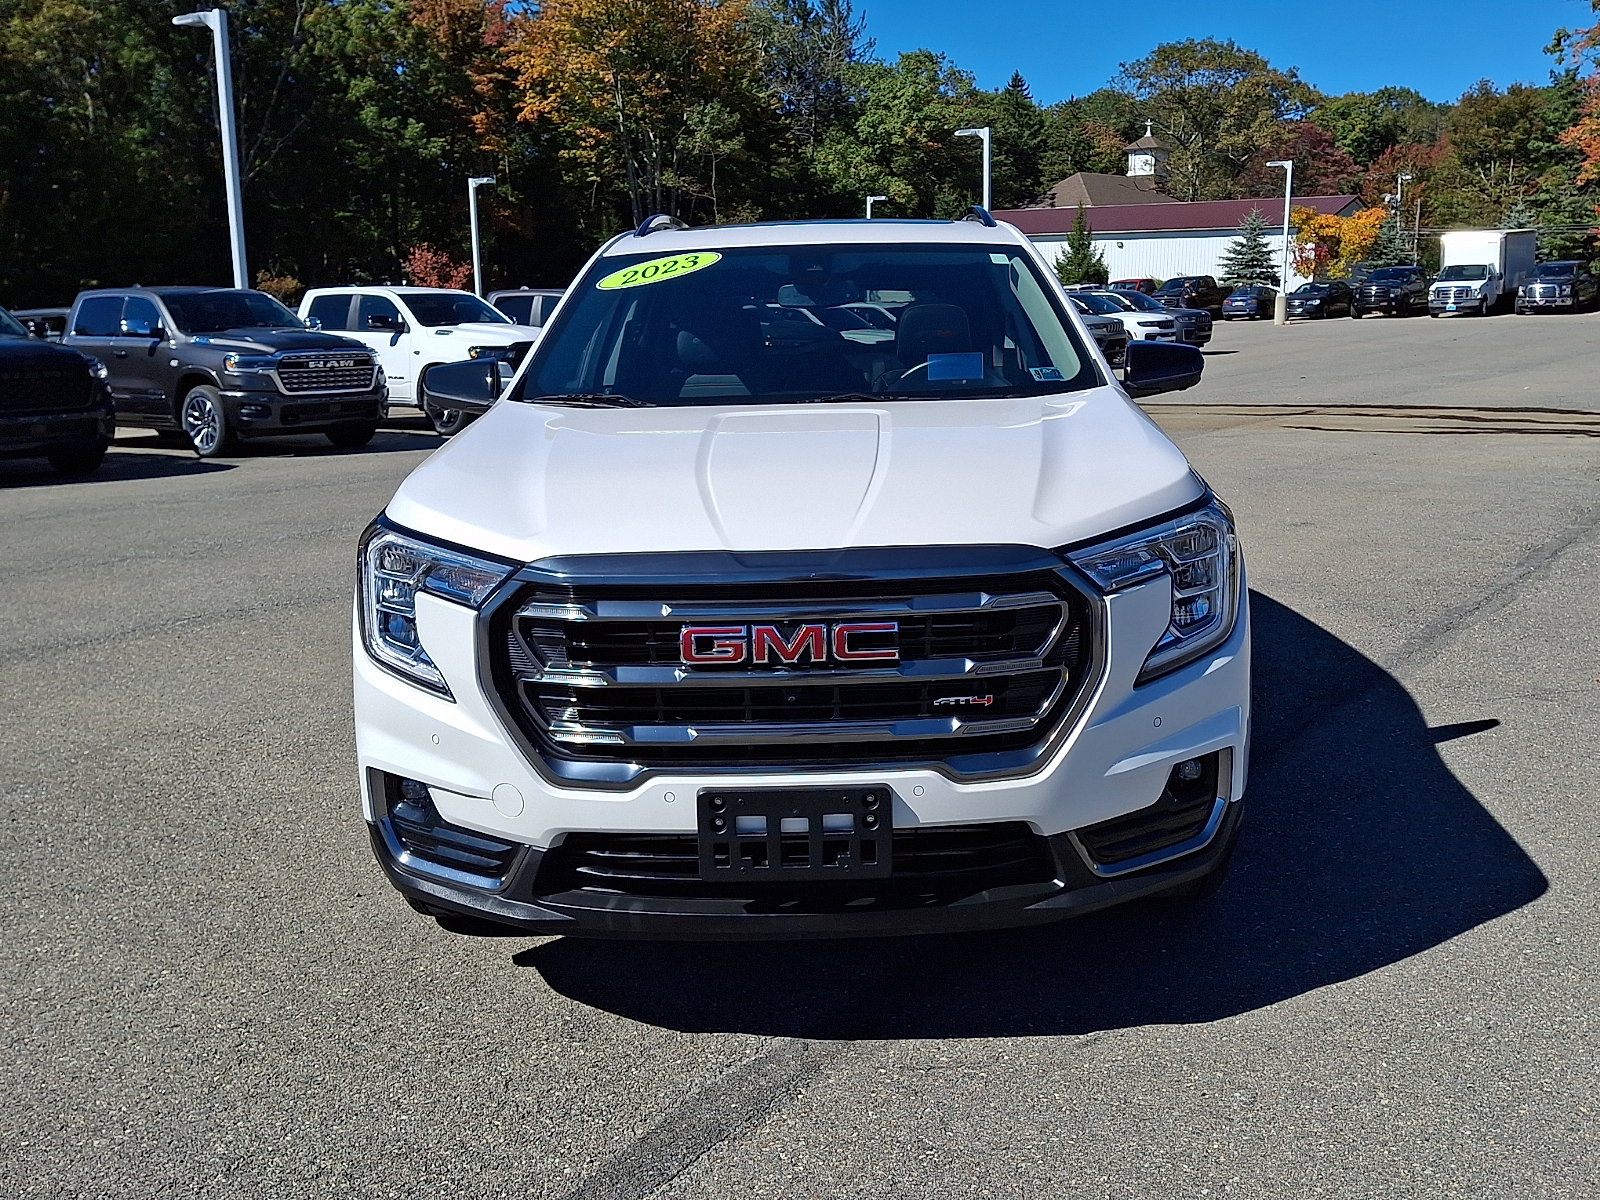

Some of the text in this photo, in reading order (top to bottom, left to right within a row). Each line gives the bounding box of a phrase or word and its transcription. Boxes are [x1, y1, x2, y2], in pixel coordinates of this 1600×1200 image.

[620, 255, 700, 286] 2023
[308, 360, 354, 368] RAM
[679, 622, 899, 665] GMC
[933, 694, 994, 706] AT4
